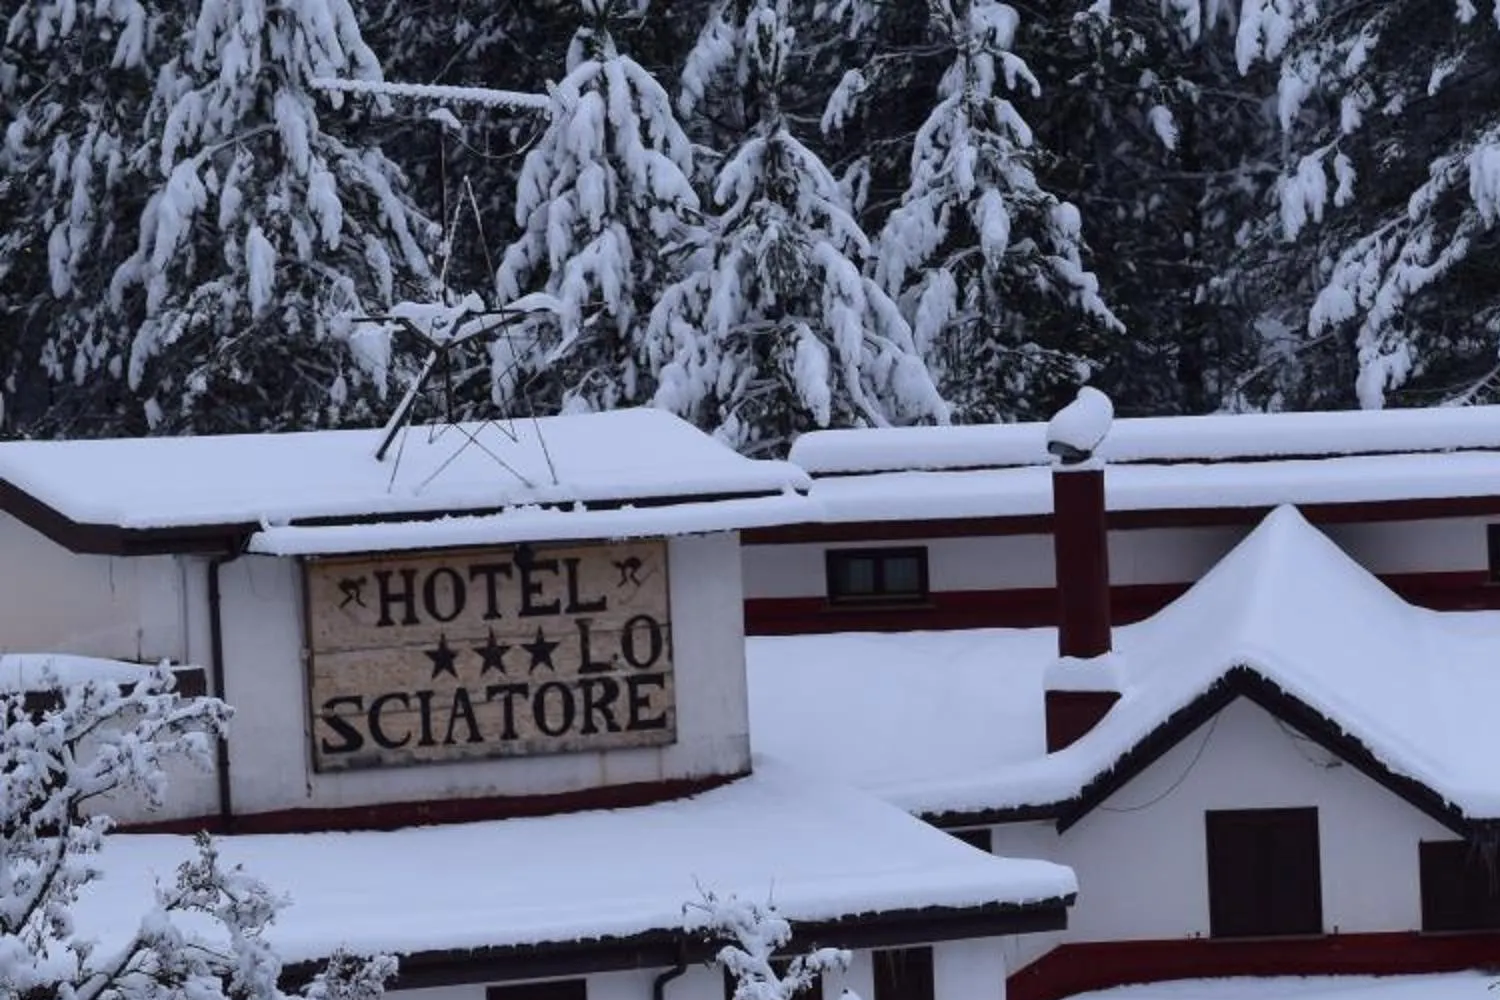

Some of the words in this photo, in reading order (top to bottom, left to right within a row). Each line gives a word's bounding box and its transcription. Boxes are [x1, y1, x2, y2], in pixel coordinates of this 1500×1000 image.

[374, 558, 607, 627] HOTEL
[575, 614, 663, 674] LO
[321, 674, 666, 754] SCIATORE
